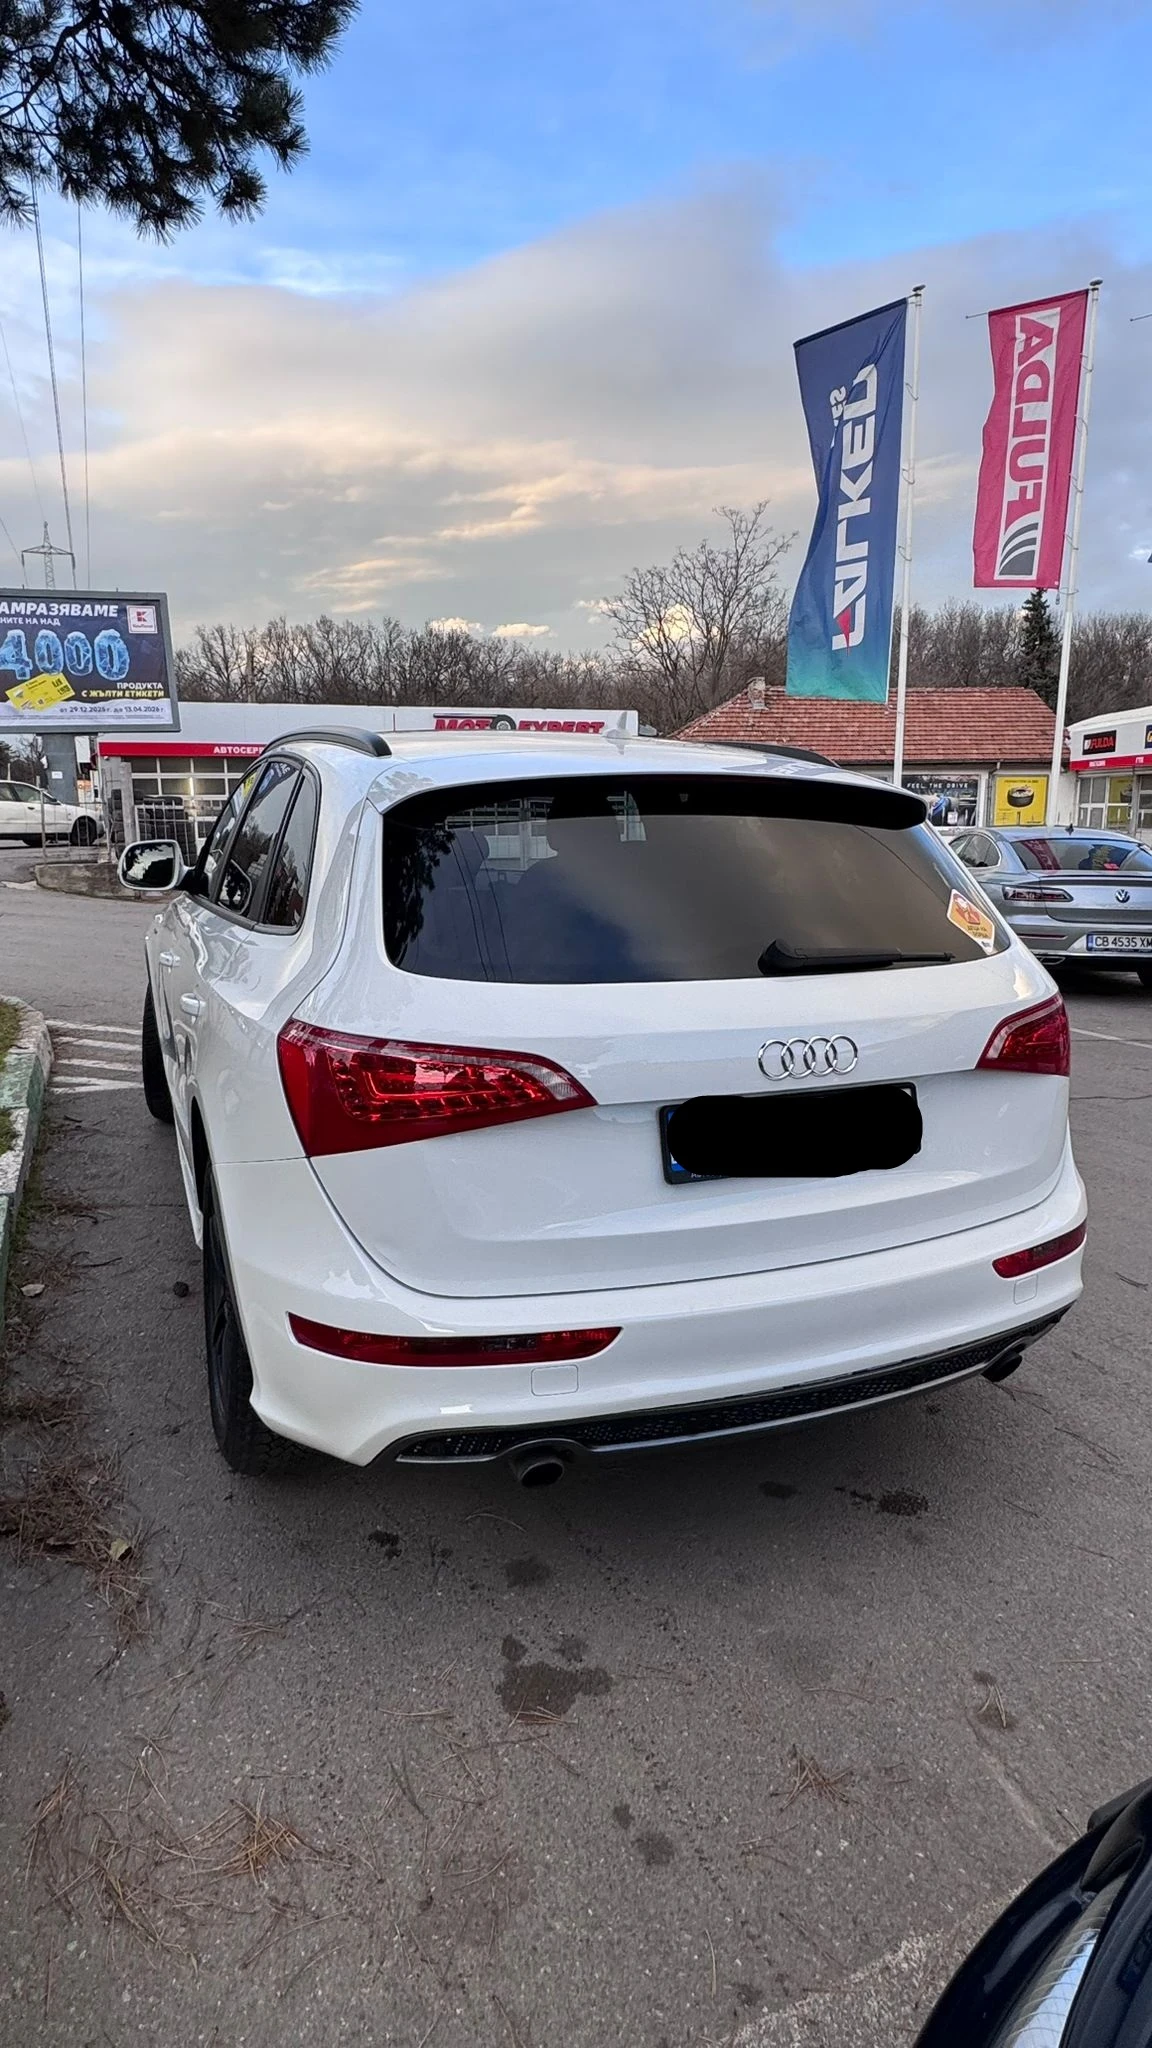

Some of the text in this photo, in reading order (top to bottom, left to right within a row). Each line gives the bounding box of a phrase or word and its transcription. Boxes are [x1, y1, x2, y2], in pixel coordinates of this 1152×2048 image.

[40, 618, 61, 626] НАД
[0, 629, 131, 681] 4000
[117, 682, 163, 690] ПРОДУКТА
[90, 690, 123, 698] ЖЪЛТИ
[125, 690, 165, 698] ЕТИКЕТИ
[1095, 936, 1109, 946] CB
[1111, 936, 1137, 947] 4535
